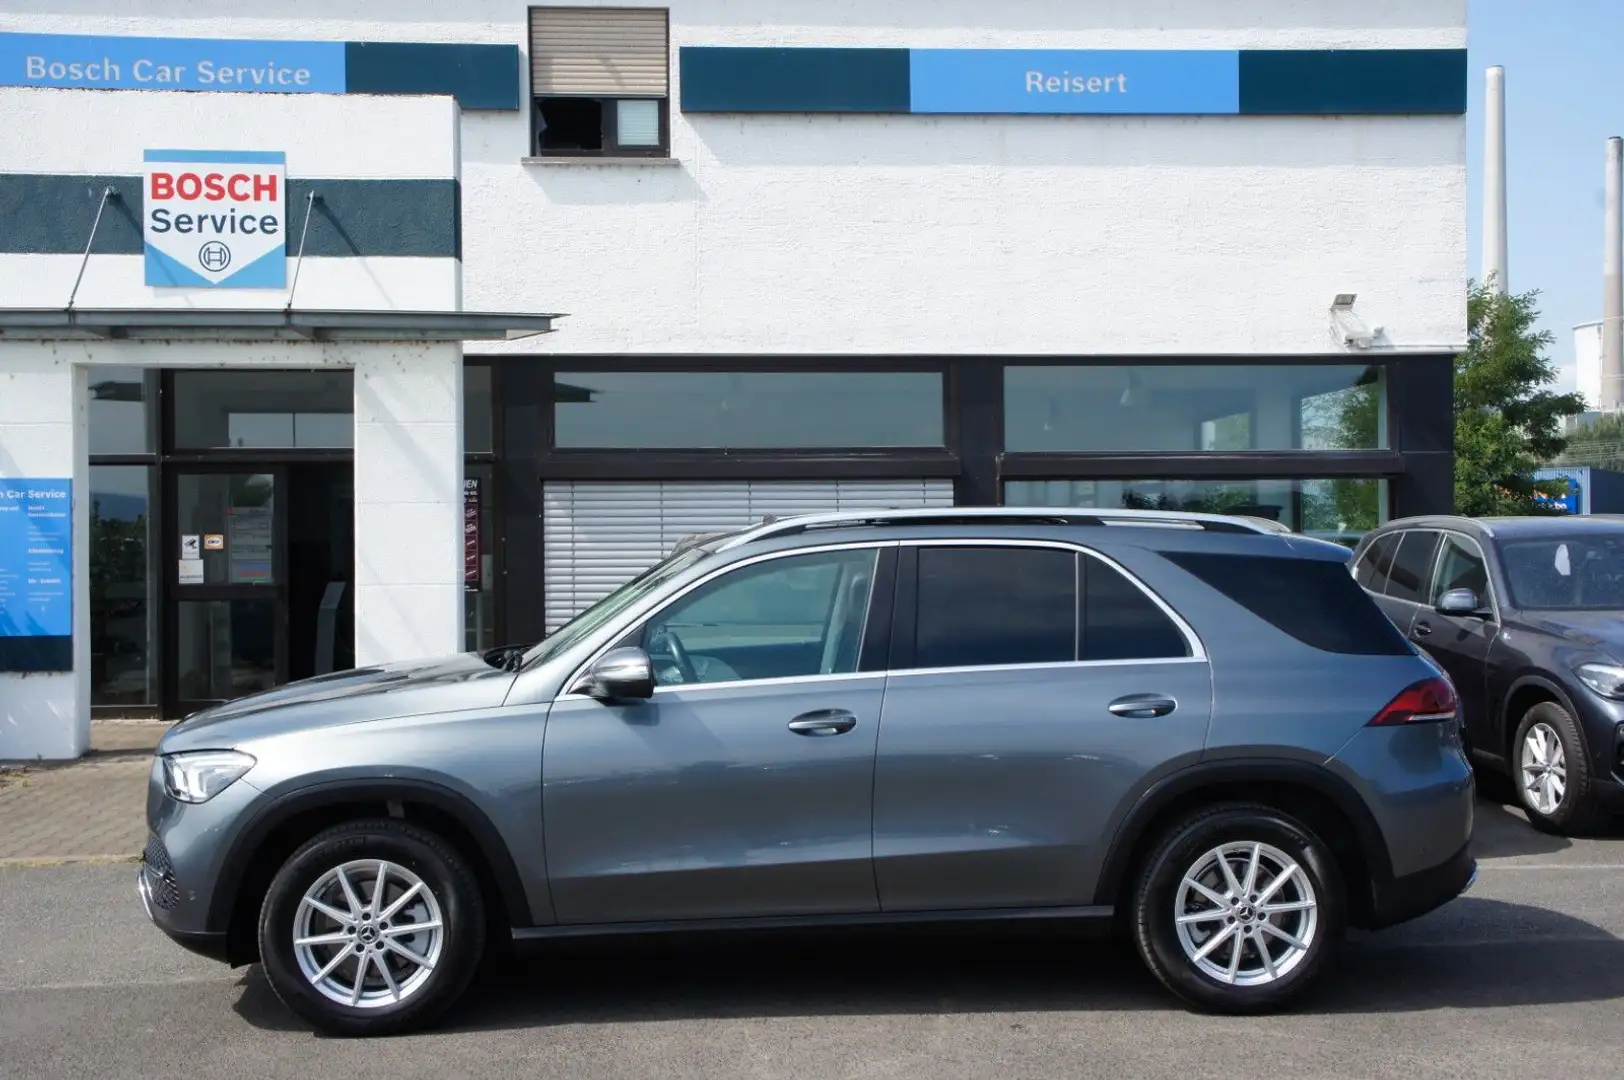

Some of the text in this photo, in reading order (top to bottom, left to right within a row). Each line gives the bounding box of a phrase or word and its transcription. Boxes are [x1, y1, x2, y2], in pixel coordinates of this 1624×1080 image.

[25, 55, 311, 86] Bosch Car Service
[1025, 69, 1128, 93] Reisert
[151, 172, 278, 202] BOSCH
[150, 207, 279, 235] Service
[6, 489, 25, 499] Car
[28, 489, 66, 499] Service
